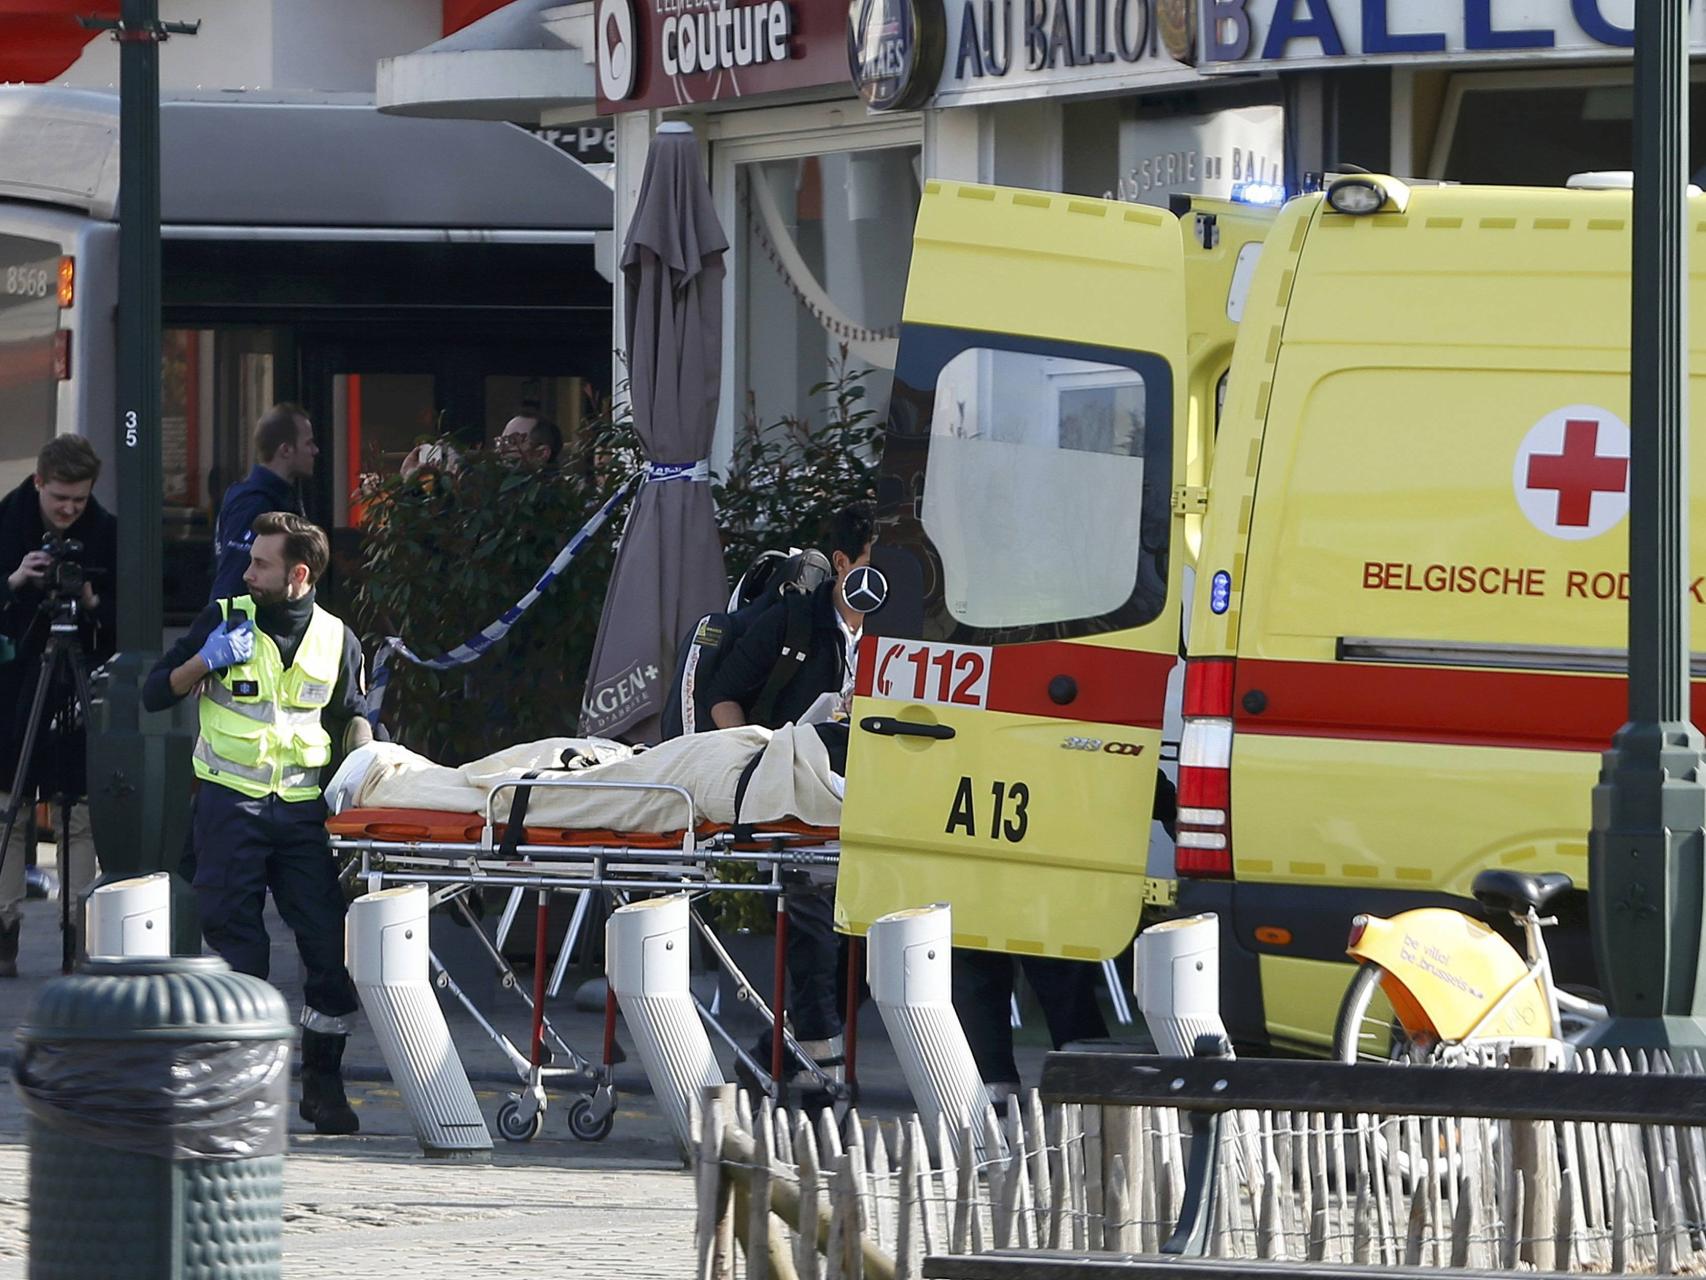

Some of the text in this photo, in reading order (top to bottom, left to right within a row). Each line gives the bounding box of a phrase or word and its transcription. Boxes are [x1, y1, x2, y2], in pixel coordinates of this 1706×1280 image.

[661, 0, 788, 76] couture
[955, 0, 1010, 79] AU
[7, 266, 48, 297] 8568
[1362, 562, 1545, 596] BELGISCHE
[907, 646, 985, 706] 112
[945, 776, 1029, 843] A 13
